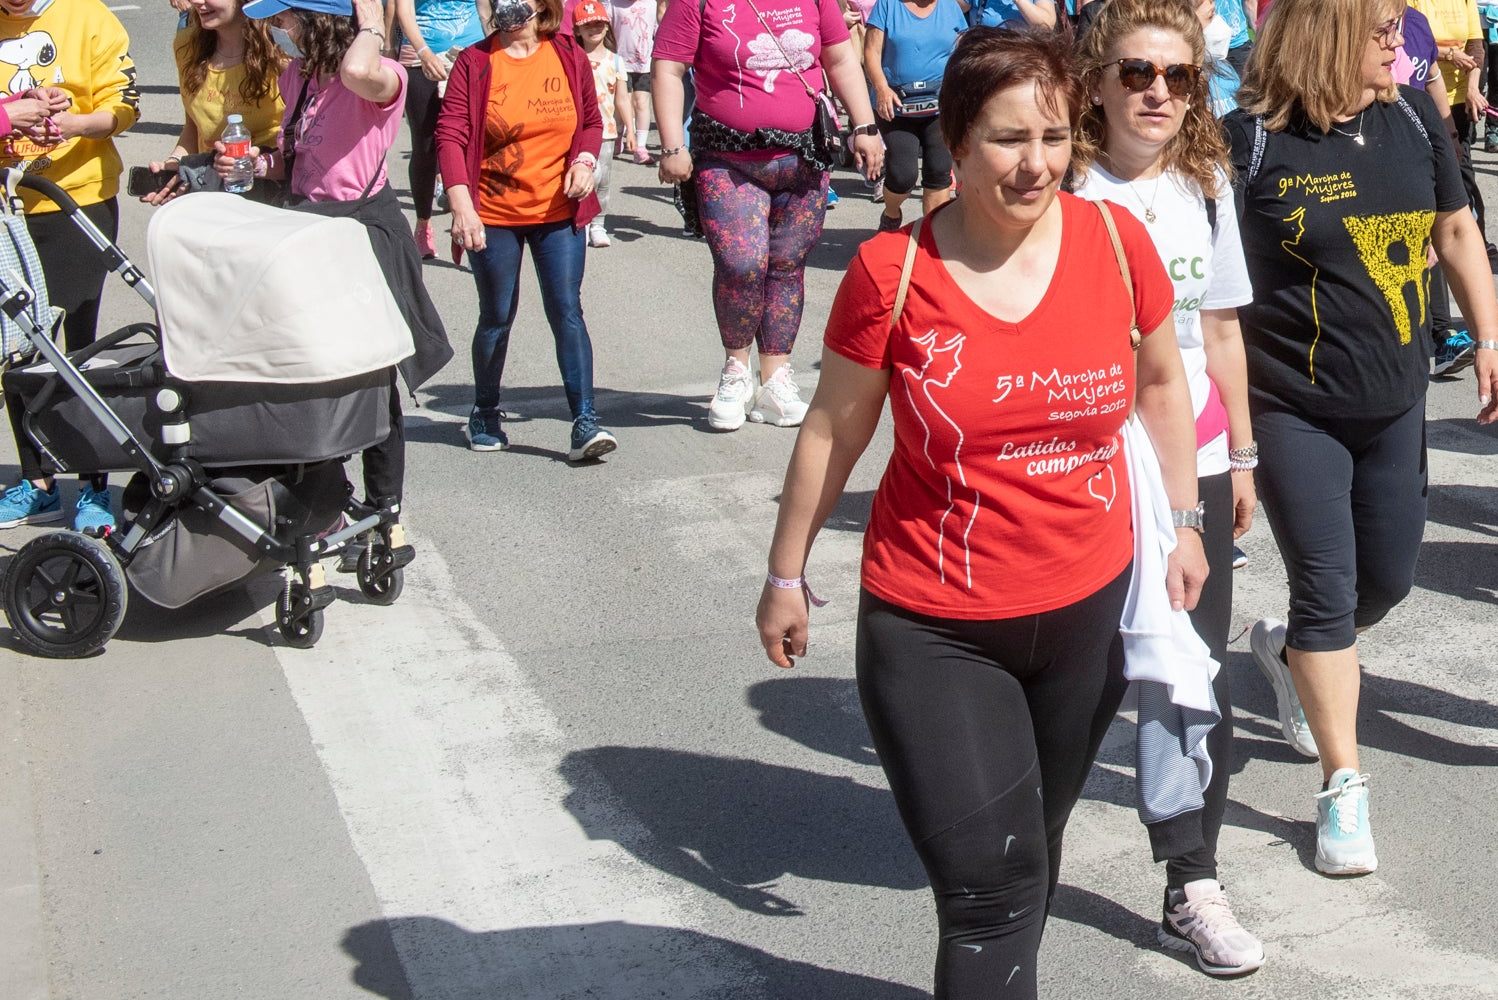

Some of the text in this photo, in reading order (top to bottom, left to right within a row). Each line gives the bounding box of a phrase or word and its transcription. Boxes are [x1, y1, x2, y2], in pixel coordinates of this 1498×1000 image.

[542, 77, 561, 93] 10
[527, 98, 563, 110] Marcha
[905, 102, 937, 112] FILA
[1296, 173, 1338, 188] Marcha
[1340, 171, 1351, 179] de
[1305, 181, 1354, 196] Mujeres
[1319, 190, 1357, 204] Segovia 2016
[1030, 367, 1106, 392] Marcha
[1109, 362, 1123, 377] de
[1047, 379, 1126, 405] Mujeres
[1100, 398, 1127, 414] 2012
[996, 436, 1076, 461] Latidos
